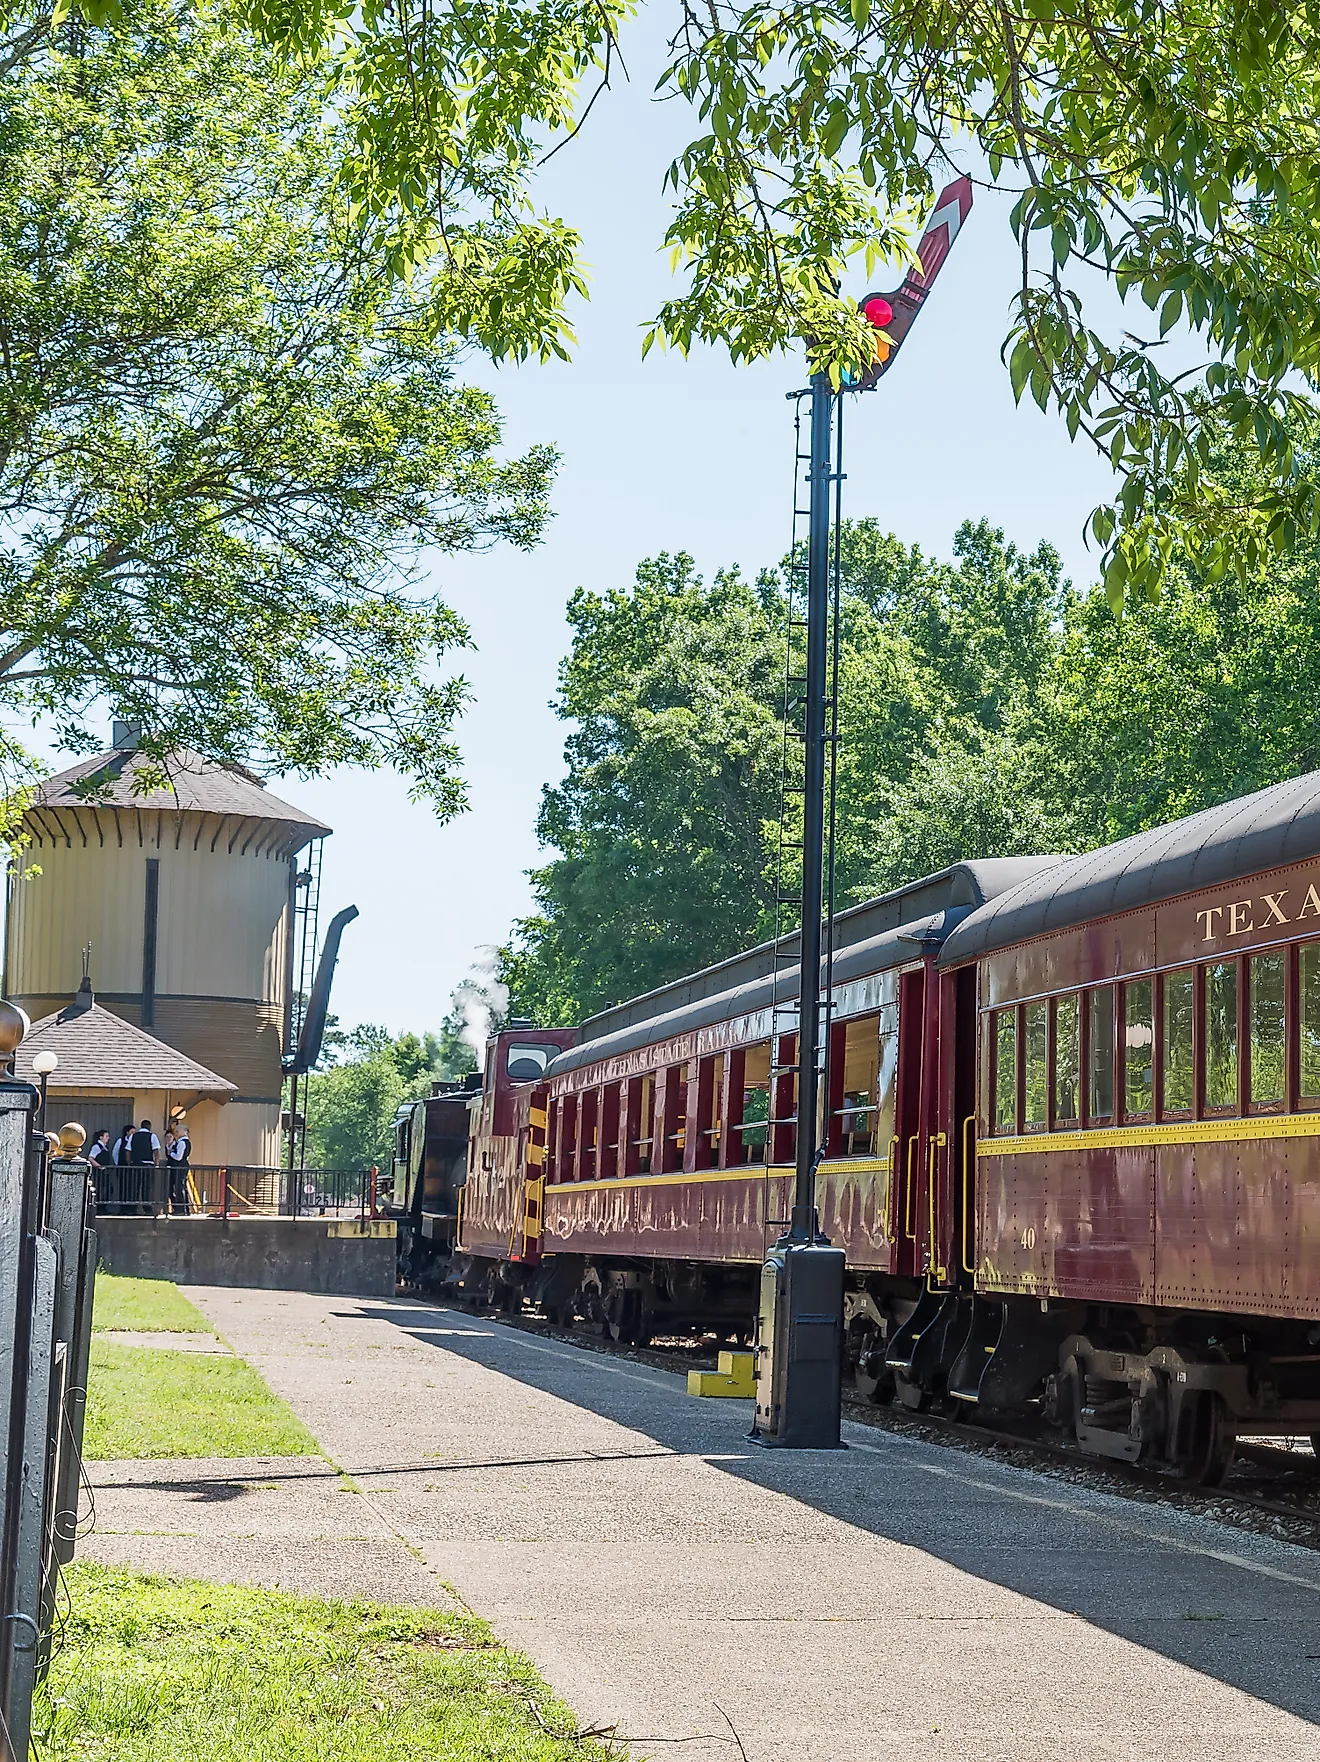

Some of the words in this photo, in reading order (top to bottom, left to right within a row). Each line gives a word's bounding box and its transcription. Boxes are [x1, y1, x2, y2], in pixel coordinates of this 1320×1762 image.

[612, 1053, 647, 1077] TEXAS
[652, 1040, 690, 1067] STATE
[697, 1015, 765, 1054] RAILROAD
[1021, 1227, 1036, 1250] 40
